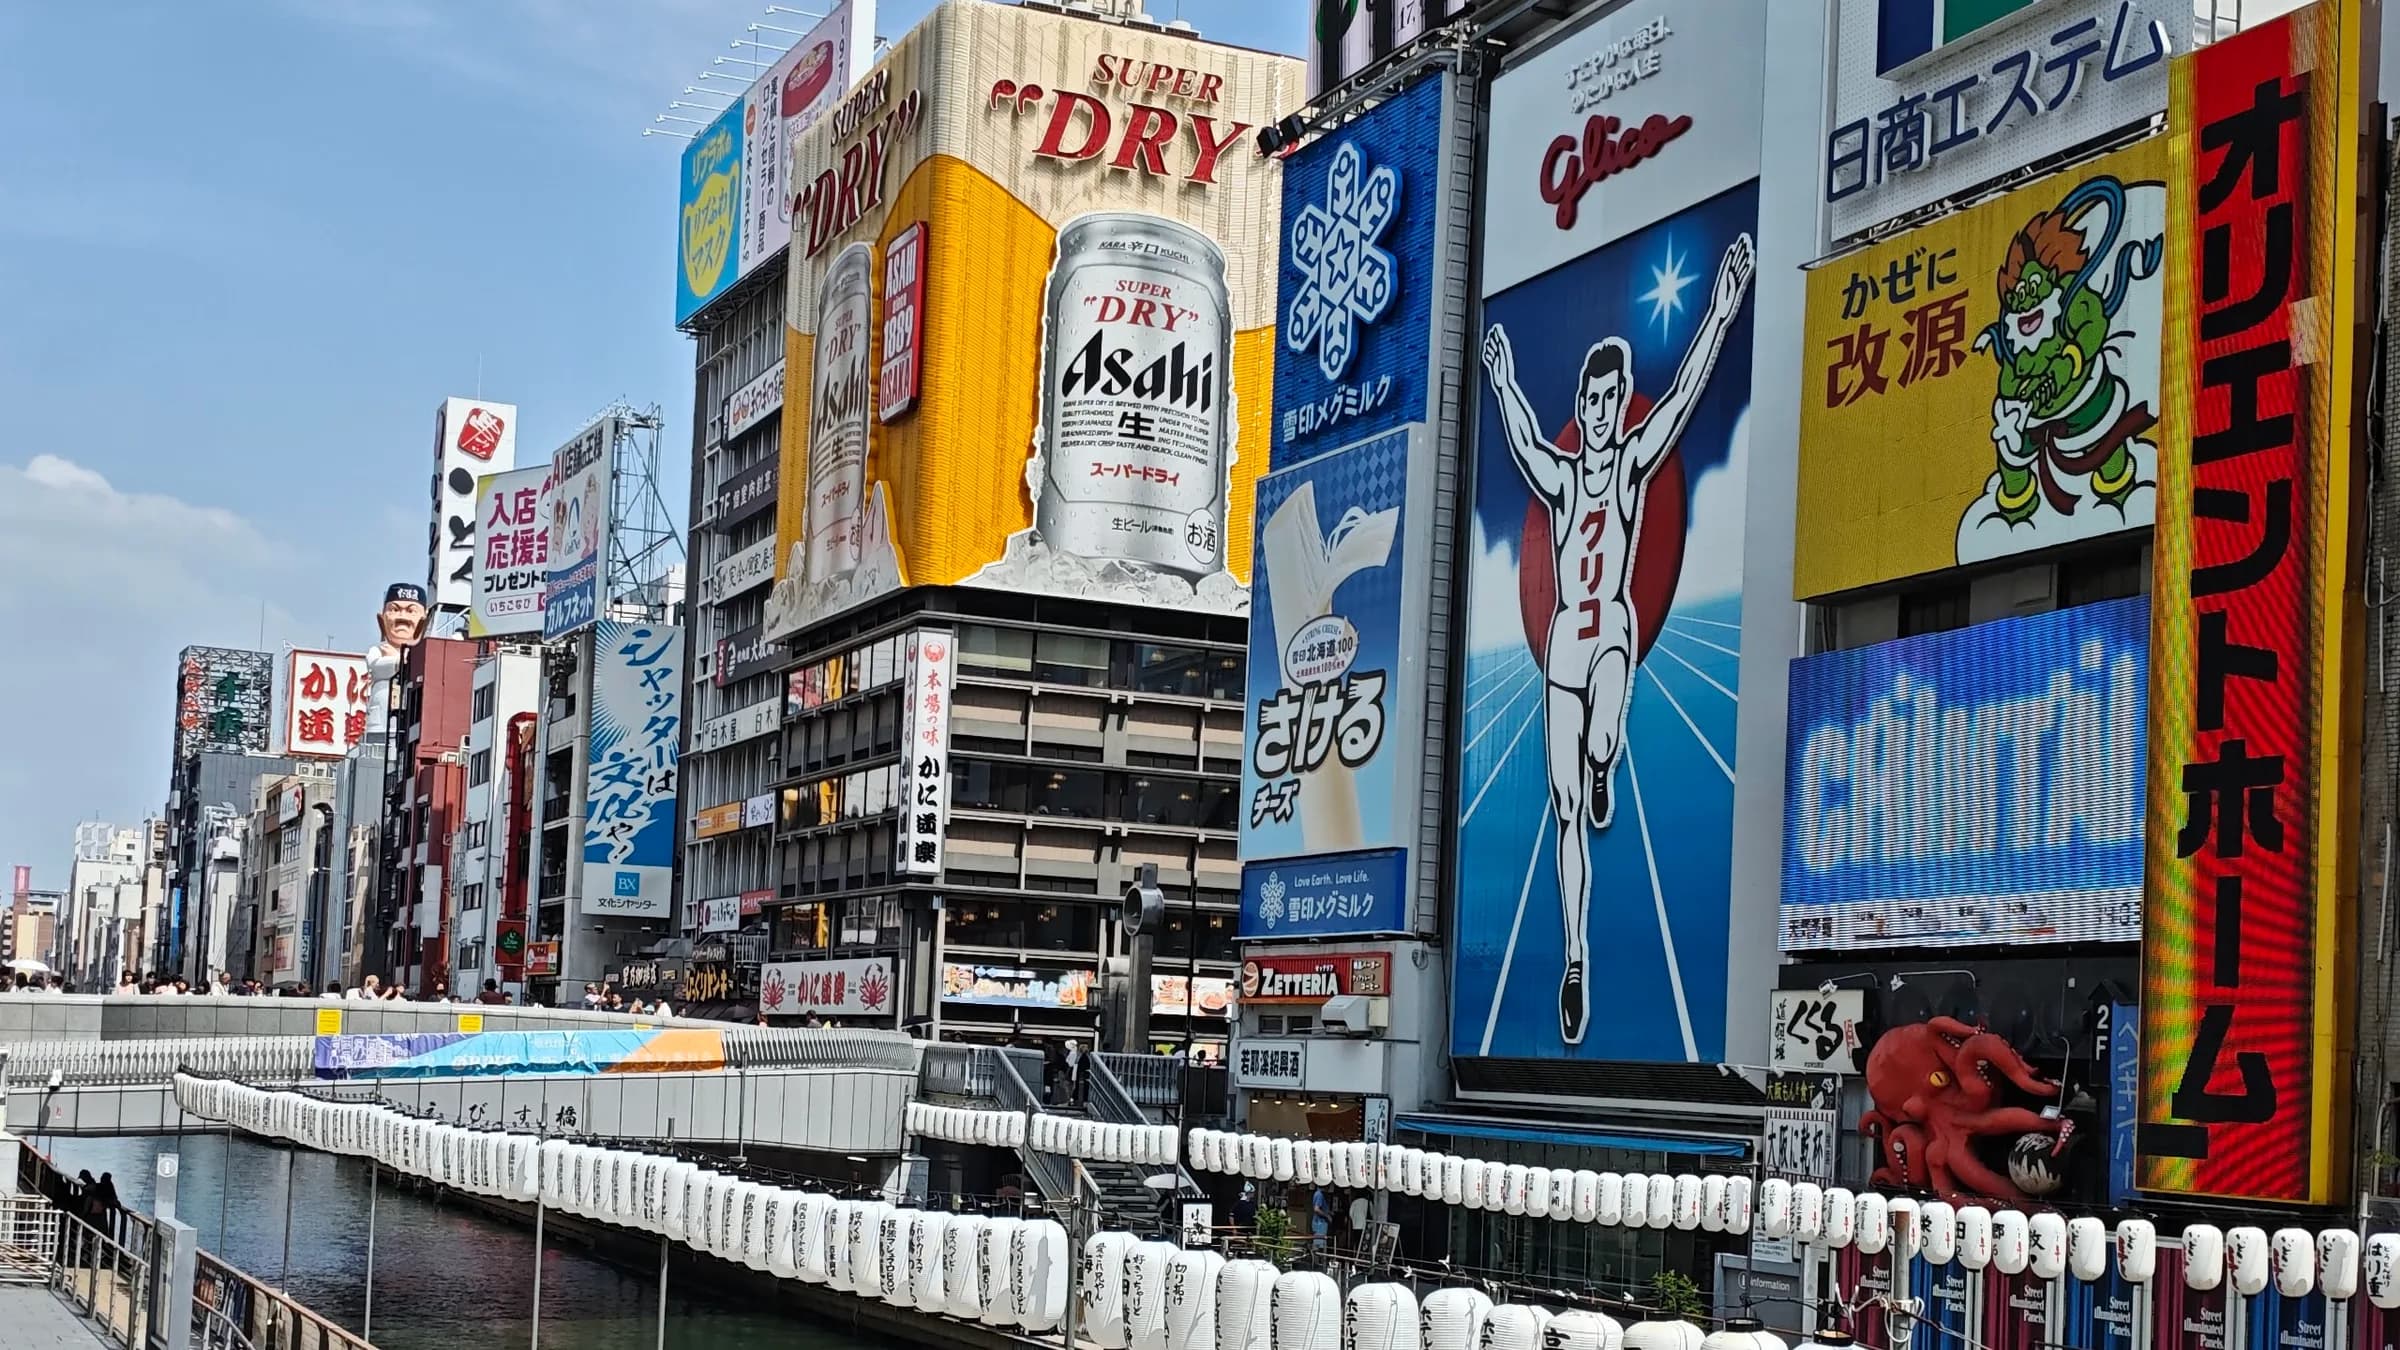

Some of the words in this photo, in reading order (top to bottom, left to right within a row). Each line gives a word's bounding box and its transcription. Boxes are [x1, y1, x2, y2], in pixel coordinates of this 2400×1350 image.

[1092, 53, 1224, 103] SUPER
[831, 68, 888, 147] SUPER
[1827, 2, 2168, 203] 日商エステム
[1540, 114, 1693, 231] Glico
[886, 239, 917, 294] ASAHI
[1842, 247, 1957, 320] かぜに
[1115, 279, 1171, 299] SUPER
[883, 305, 913, 362] 1889
[1827, 289, 1969, 408] 改源
[880, 357, 912, 412] OSAKA
[1061, 328, 1213, 414] Asahi
[816, 355, 866, 436] Asahi
[1282, 374, 1393, 442] 雪印メグミルク
[1118, 411, 1155, 441] 生
[831, 436, 845, 463] 生
[1090, 462, 1180, 486] スーパードライ
[487, 487, 537, 529] 入店
[1112, 518, 1151, 533] 生ビール
[485, 527, 550, 570] 応援金
[1187, 519, 1216, 553] お酒
[1578, 500, 1609, 640] グリコ
[548, 592, 594, 633] ガルフネット
[2172, 77, 2302, 1125] オリエントホーム
[300, 663, 372, 702] かに
[298, 707, 367, 745] 道楽
[618, 629, 680, 796] シャッターは
[922, 668, 942, 748] 本場の味
[1253, 668, 1386, 779] さける
[914, 755, 941, 864] かに道楽
[1250, 778, 1301, 830] チーズ
[618, 876, 637, 892] BX
[1294, 875, 1311, 887] Love
[1311, 873, 1333, 887] Earth.
[1335, 871, 1352, 885] Love
[1353, 869, 1370, 884] Life.
[598, 897, 659, 911] 文化シャッター
[1288, 890, 1375, 923] 雪印メグミルク
[798, 970, 846, 1007] かに道楽
[1261, 967, 1339, 996] ZETTERIA
[1787, 1000, 1844, 1060] くくる
[2096, 1004, 2109, 1061] 2F
[425, 1101, 577, 1128] えびす橋
[1872, 1265, 1889, 1278] Street
[1946, 1275, 1964, 1288] Street
[2367, 1242, 2384, 1298] はり重
[2024, 1285, 2043, 1298] Street
[2109, 1296, 2129, 1311] Street
[2200, 1307, 2222, 1322] Street
[2298, 1320, 2321, 1335] Street
